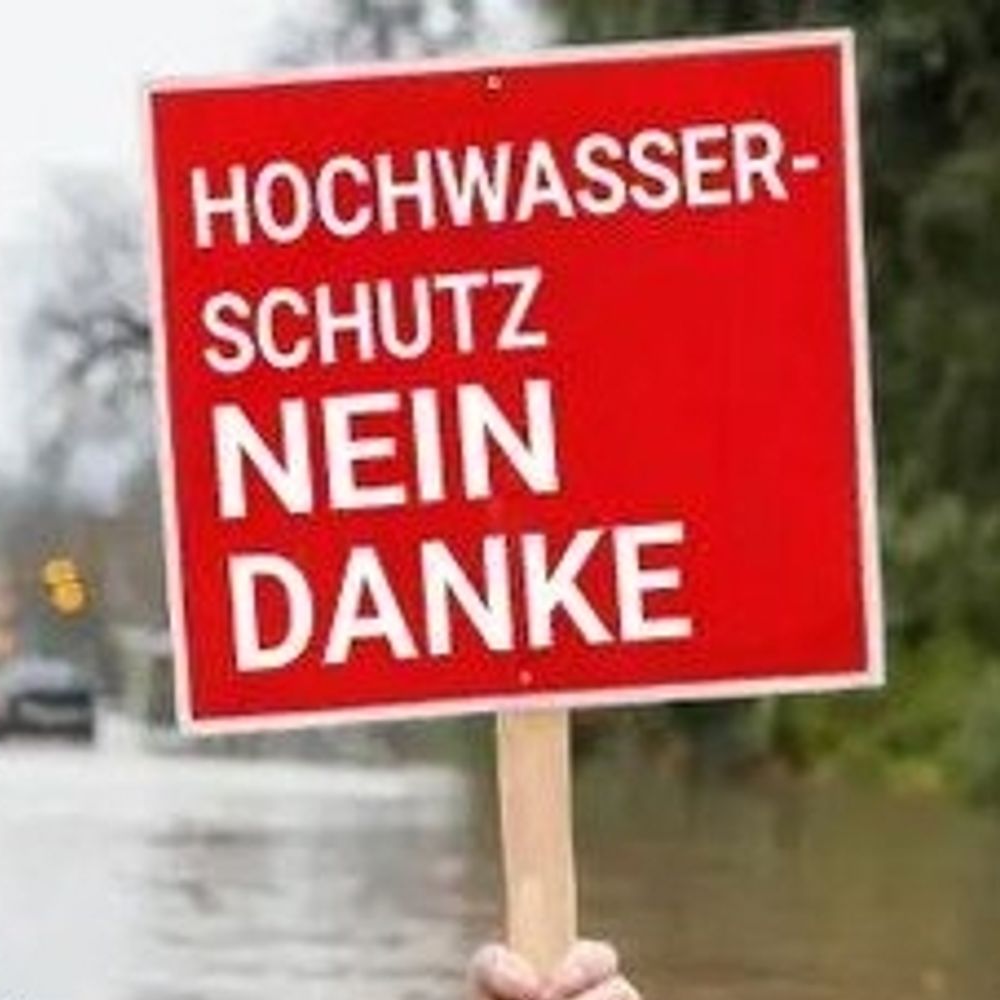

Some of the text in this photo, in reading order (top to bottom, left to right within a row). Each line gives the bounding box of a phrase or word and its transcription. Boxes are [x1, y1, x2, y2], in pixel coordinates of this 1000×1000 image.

[190, 121, 819, 250] HOCHWASSER-
[201, 267, 548, 374] SCHUTZ
[212, 379, 560, 519] NEIN
[227, 521, 693, 672] DANKE
